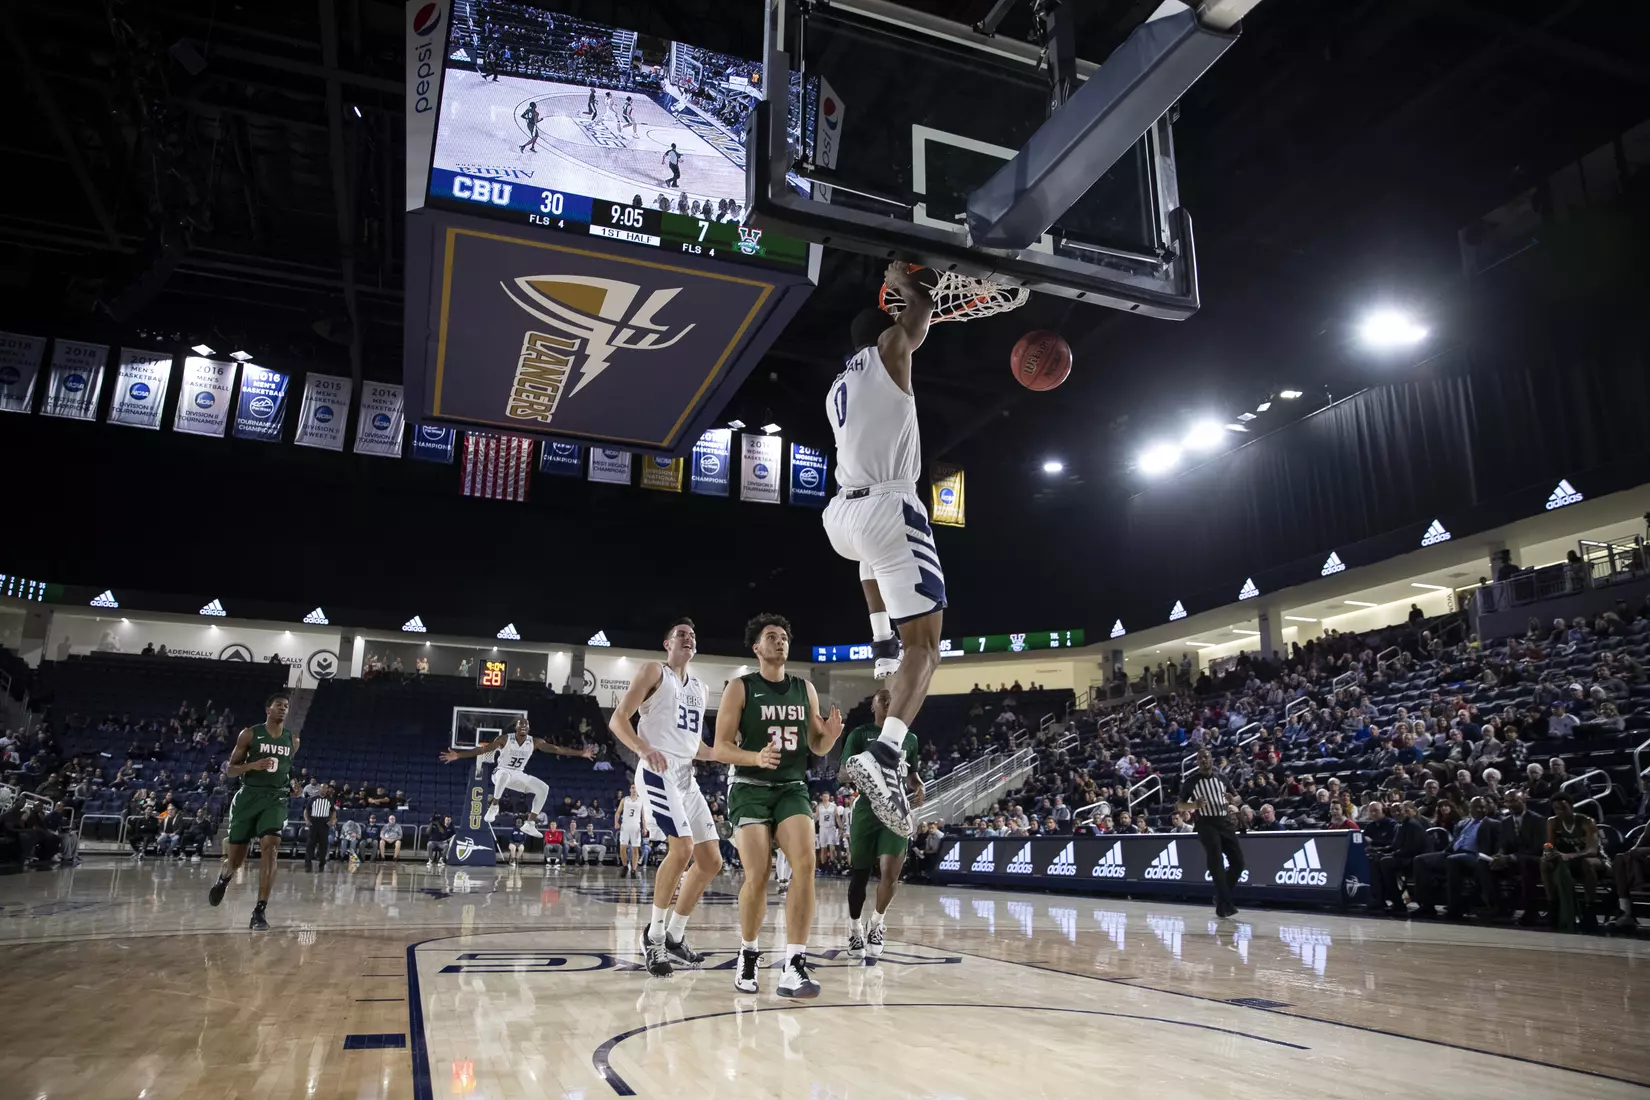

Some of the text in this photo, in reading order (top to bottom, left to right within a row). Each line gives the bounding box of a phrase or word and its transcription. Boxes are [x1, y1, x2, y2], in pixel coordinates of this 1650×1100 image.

[415, 42, 435, 114] pepsi
[452, 175, 564, 214] CBU 30
[529, 214, 565, 228] FLS 4
[611, 205, 644, 228] 9:05
[602, 227, 653, 244] 1ST HALF
[698, 221, 709, 242] 7
[682, 243, 716, 257] FLS 4
[131, 355, 159, 366] 2017
[130, 366, 155, 374] MEN'S
[196, 367, 224, 376] 2016
[196, 375, 219, 383] MEN'S
[252, 371, 281, 383] 016
[505, 331, 582, 423] LANCERS
[253, 380, 276, 389] MEN'S
[315, 380, 342, 391] 2015
[372, 388, 398, 398] 2014
[178, 415, 224, 426] TOURNAMENT
[185, 410, 213, 419] DIVISION
[794, 453, 823, 463] WOMEN'S
[691, 476, 727, 484] CHAMPIONS
[1545, 492, 1583, 510] adidas
[1421, 531, 1451, 547] adidas
[1321, 562, 1346, 576] adidas
[1238, 588, 1259, 600] adidas
[90, 600, 119, 608] adidas
[199, 608, 226, 617] adidas
[1169, 609, 1187, 621] adidas
[303, 616, 329, 625] adidas
[402, 624, 427, 633] adidas
[1110, 628, 1126, 639] adidas
[496, 632, 521, 641] adidas
[588, 639, 611, 648] adidas
[979, 637, 986, 652] 7
[167, 649, 214, 657] ADEMICALLY
[486, 661, 506, 671] 9:04
[482, 671, 502, 686] 28
[677, 704, 699, 734] 33
[760, 705, 806, 721] MVSU
[766, 725, 798, 751] 35
[259, 743, 291, 757] MVSU
[507, 756, 525, 768] 35
[469, 786, 483, 829] CBU
[939, 859, 960, 871] adidas
[971, 860, 995, 872] adidas
[1006, 861, 1033, 874] adidas
[1047, 862, 1077, 876] adidas
[1092, 863, 1126, 878] adidas
[1144, 865, 1183, 880] adidas
[1275, 867, 1327, 885] adidas
